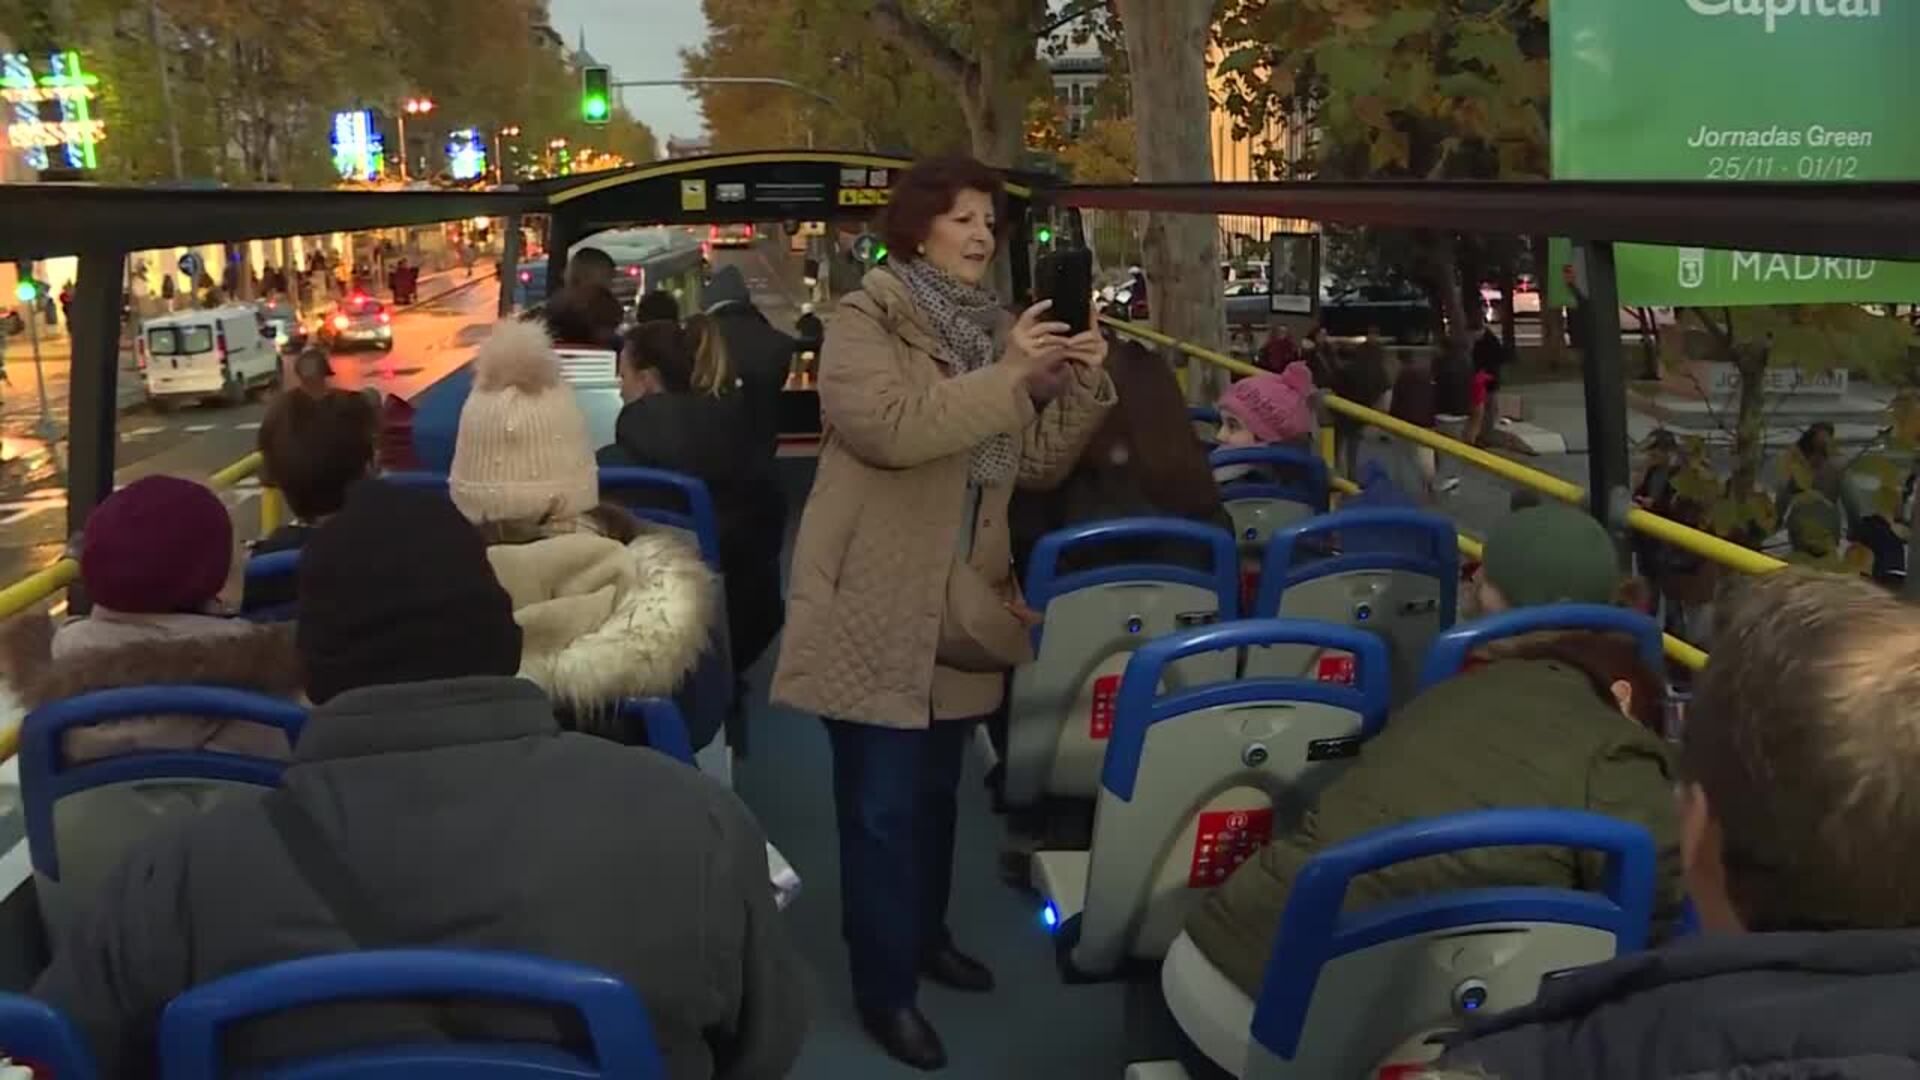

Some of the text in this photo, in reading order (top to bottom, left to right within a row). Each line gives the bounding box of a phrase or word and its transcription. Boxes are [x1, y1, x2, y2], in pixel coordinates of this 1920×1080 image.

[1688, 125, 1873, 147] Jornadas Green
[1706, 156, 1774, 179] 25/11
[1798, 156, 1858, 179] 01/12
[1732, 251, 1876, 280] MADRID
